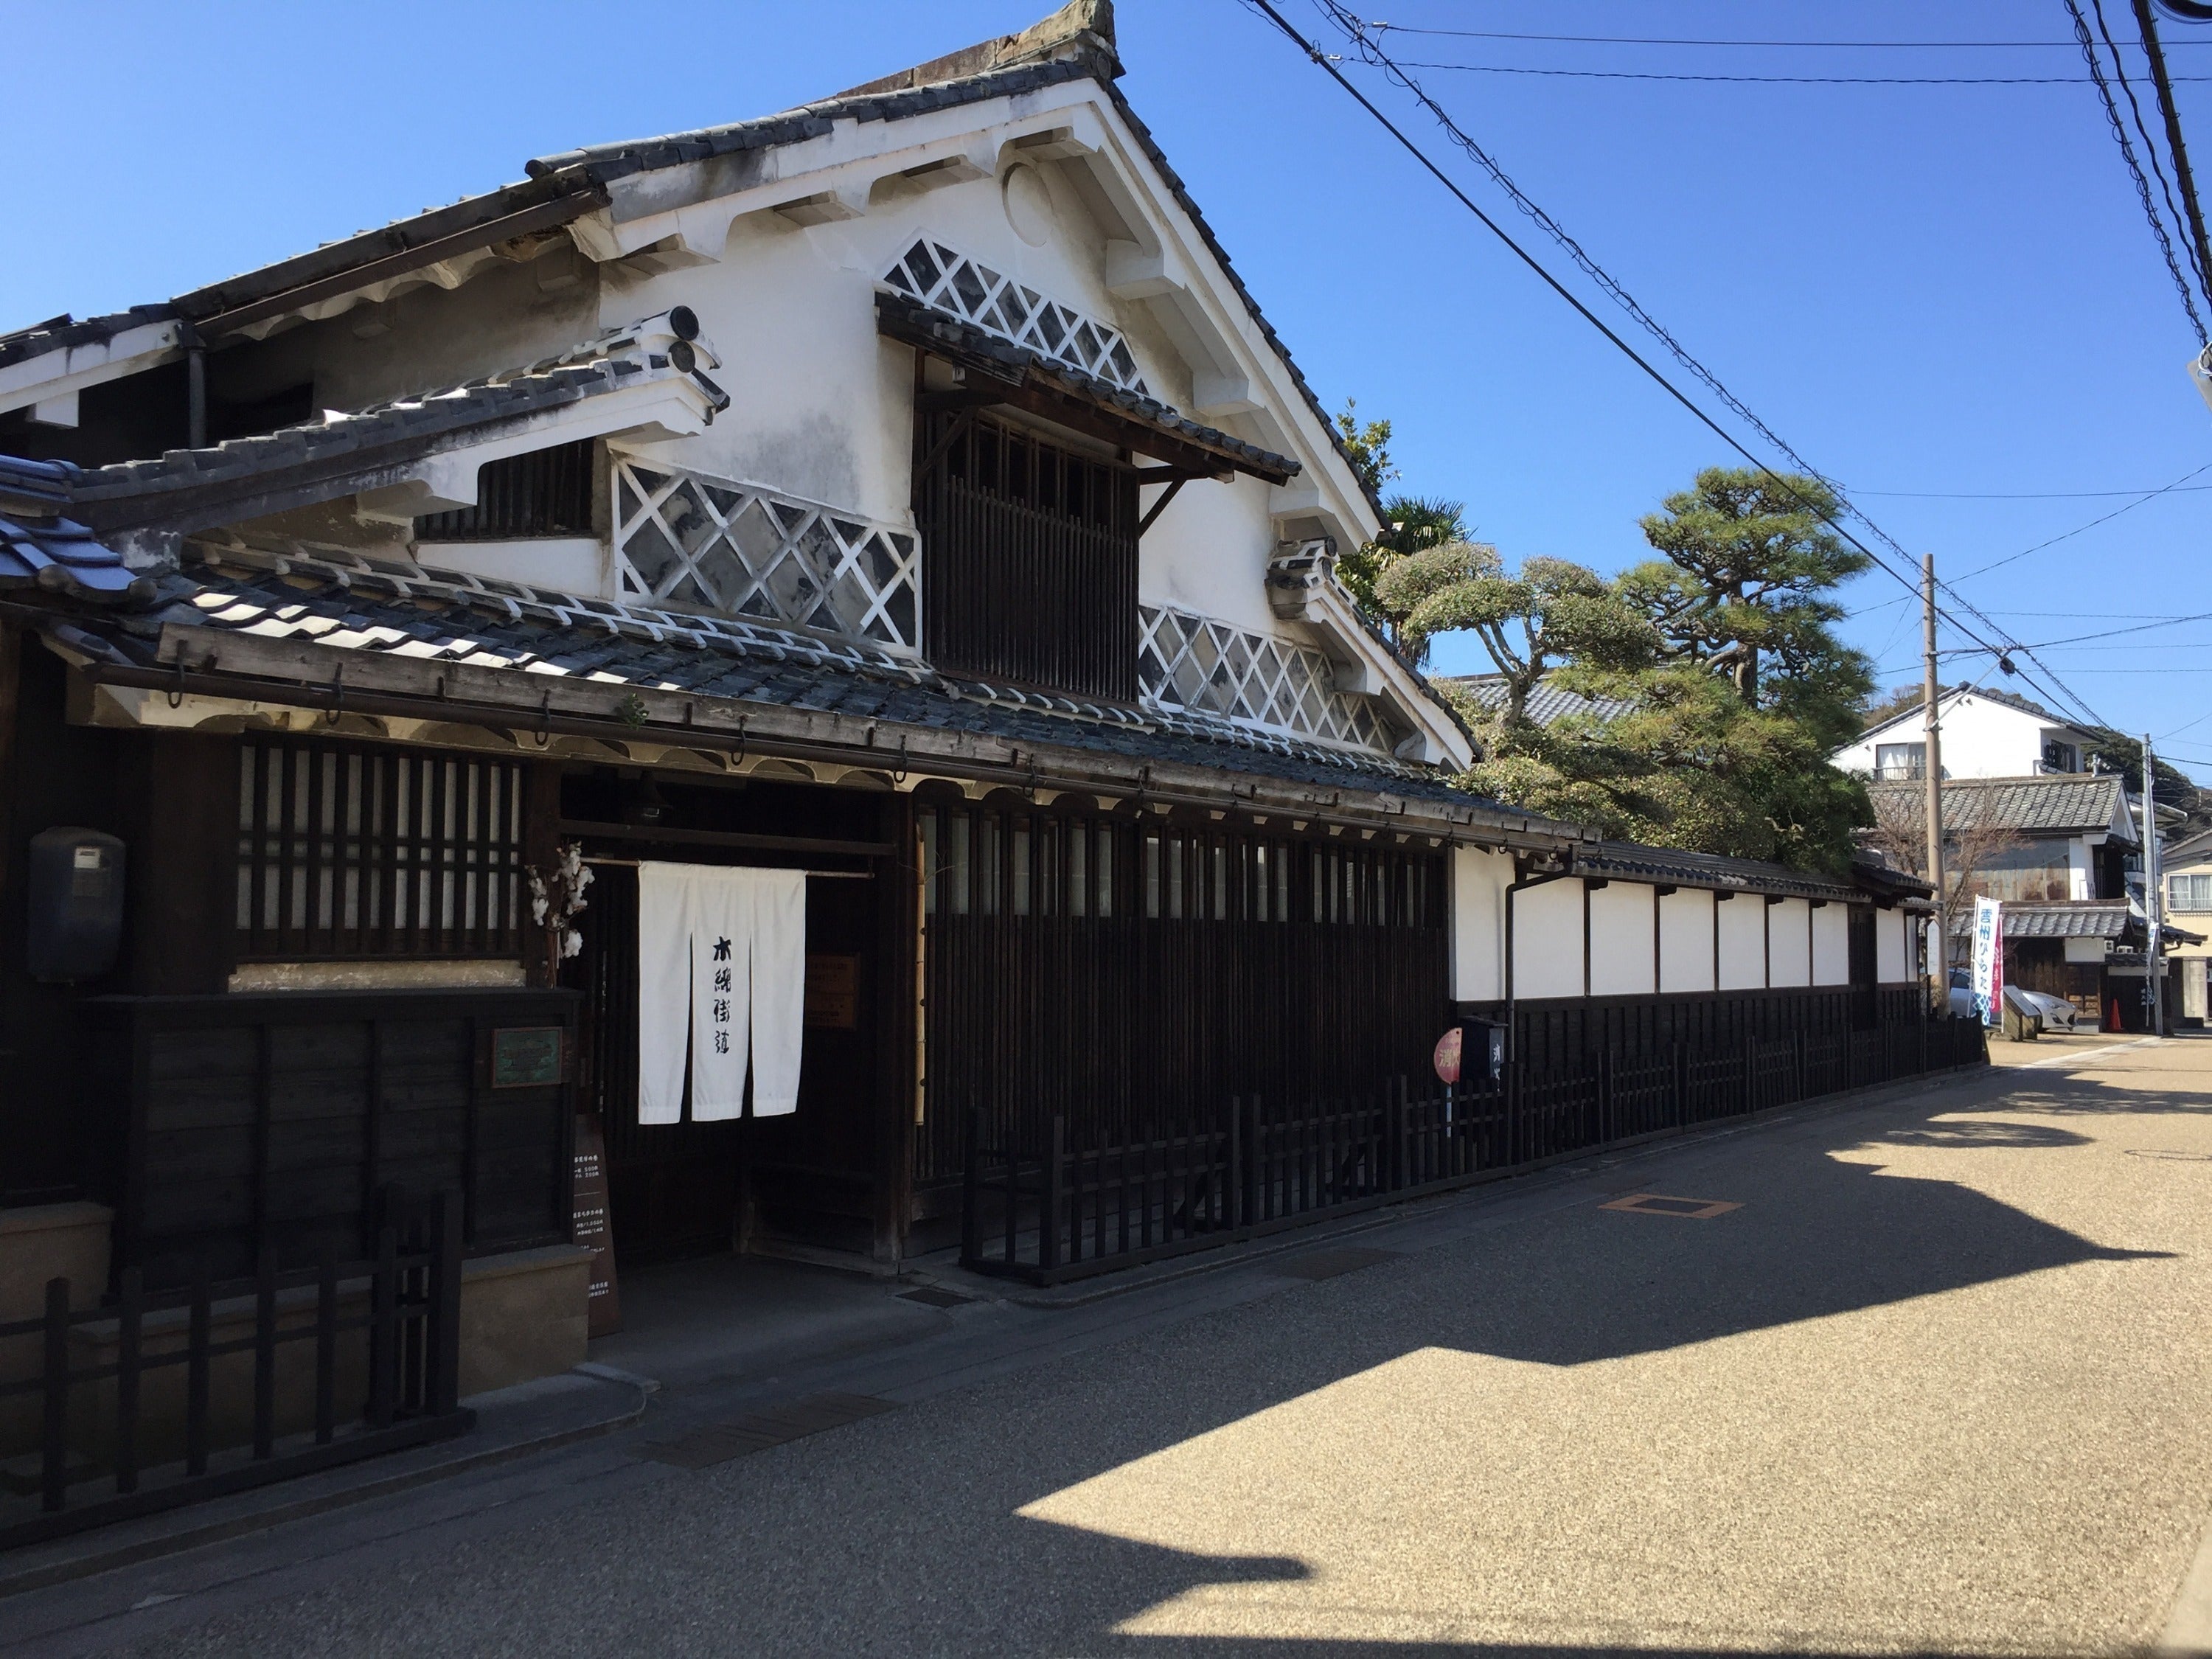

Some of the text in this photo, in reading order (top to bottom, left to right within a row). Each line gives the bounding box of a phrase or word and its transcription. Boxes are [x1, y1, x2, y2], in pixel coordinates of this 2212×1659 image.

[712, 936, 731, 1054] 木綿街道
[1980, 908, 1993, 990] 雲州ひらた
